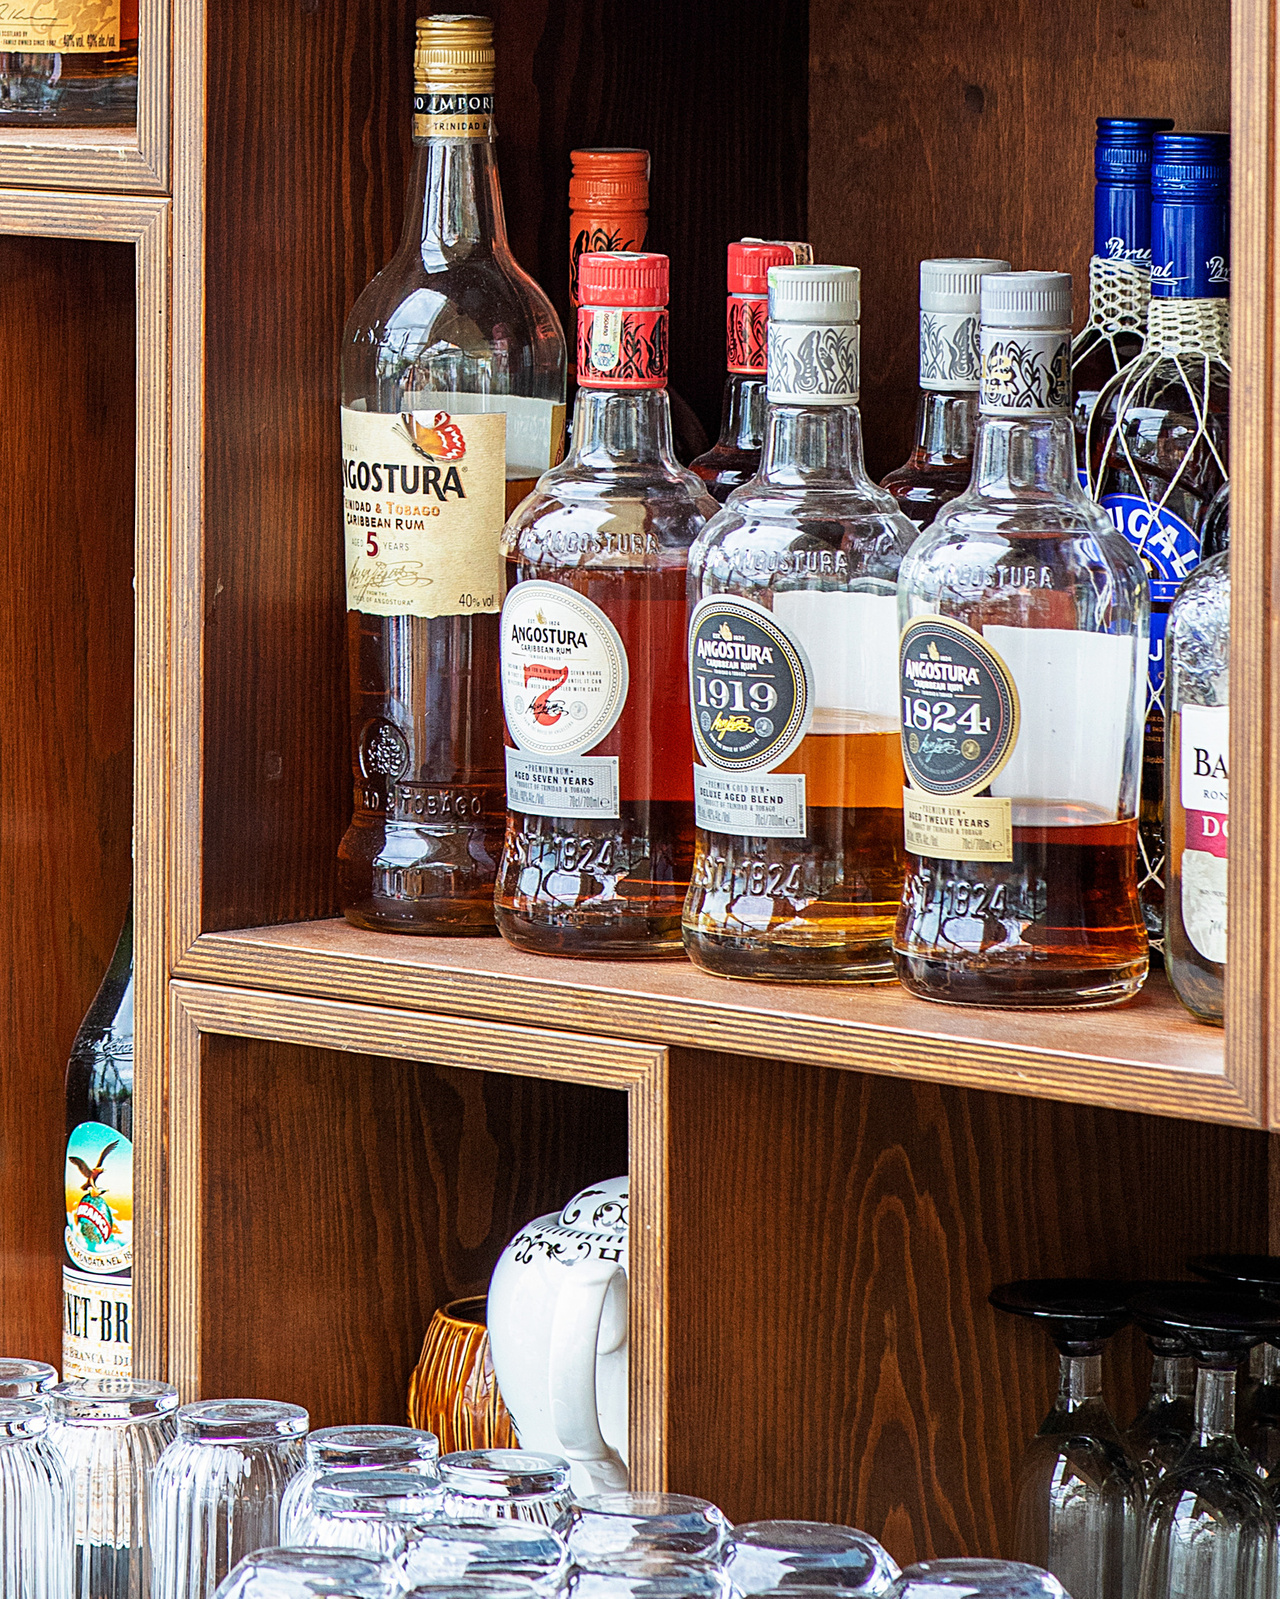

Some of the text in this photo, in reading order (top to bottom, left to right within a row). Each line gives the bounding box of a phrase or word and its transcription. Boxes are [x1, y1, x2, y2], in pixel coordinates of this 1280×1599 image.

[434, 122, 479, 130] TRINIDAD
[386, 502, 440, 517] TOBAGO
[347, 513, 425, 530] CARIBBEAN RUM
[352, 531, 410, 557] AGED 5 YEARS
[373, 596, 411, 606] ANGOSTURA
[459, 594, 494, 608] 40% vol
[511, 624, 588, 648] ANGOSTURA
[520, 644, 572, 655] CARIBBEAN RUM
[697, 638, 774, 664] ANGOSTURA
[706, 658, 757, 671] CARIBBEAN RUM
[905, 658, 980, 686] ANGOSTURA
[523, 663, 569, 727] 7
[697, 676, 778, 713] 1919
[903, 696, 991, 735] 1824
[529, 764, 553, 774] PREMIUM
[514, 771, 594, 786] AGED SEVEN YEARS
[700, 788, 784, 804] DELUXE AGED BLEND
[909, 811, 990, 828] AGED TWELVE YEARS
[743, 861, 802, 898] 1824
[946, 880, 1008, 918] 1824
